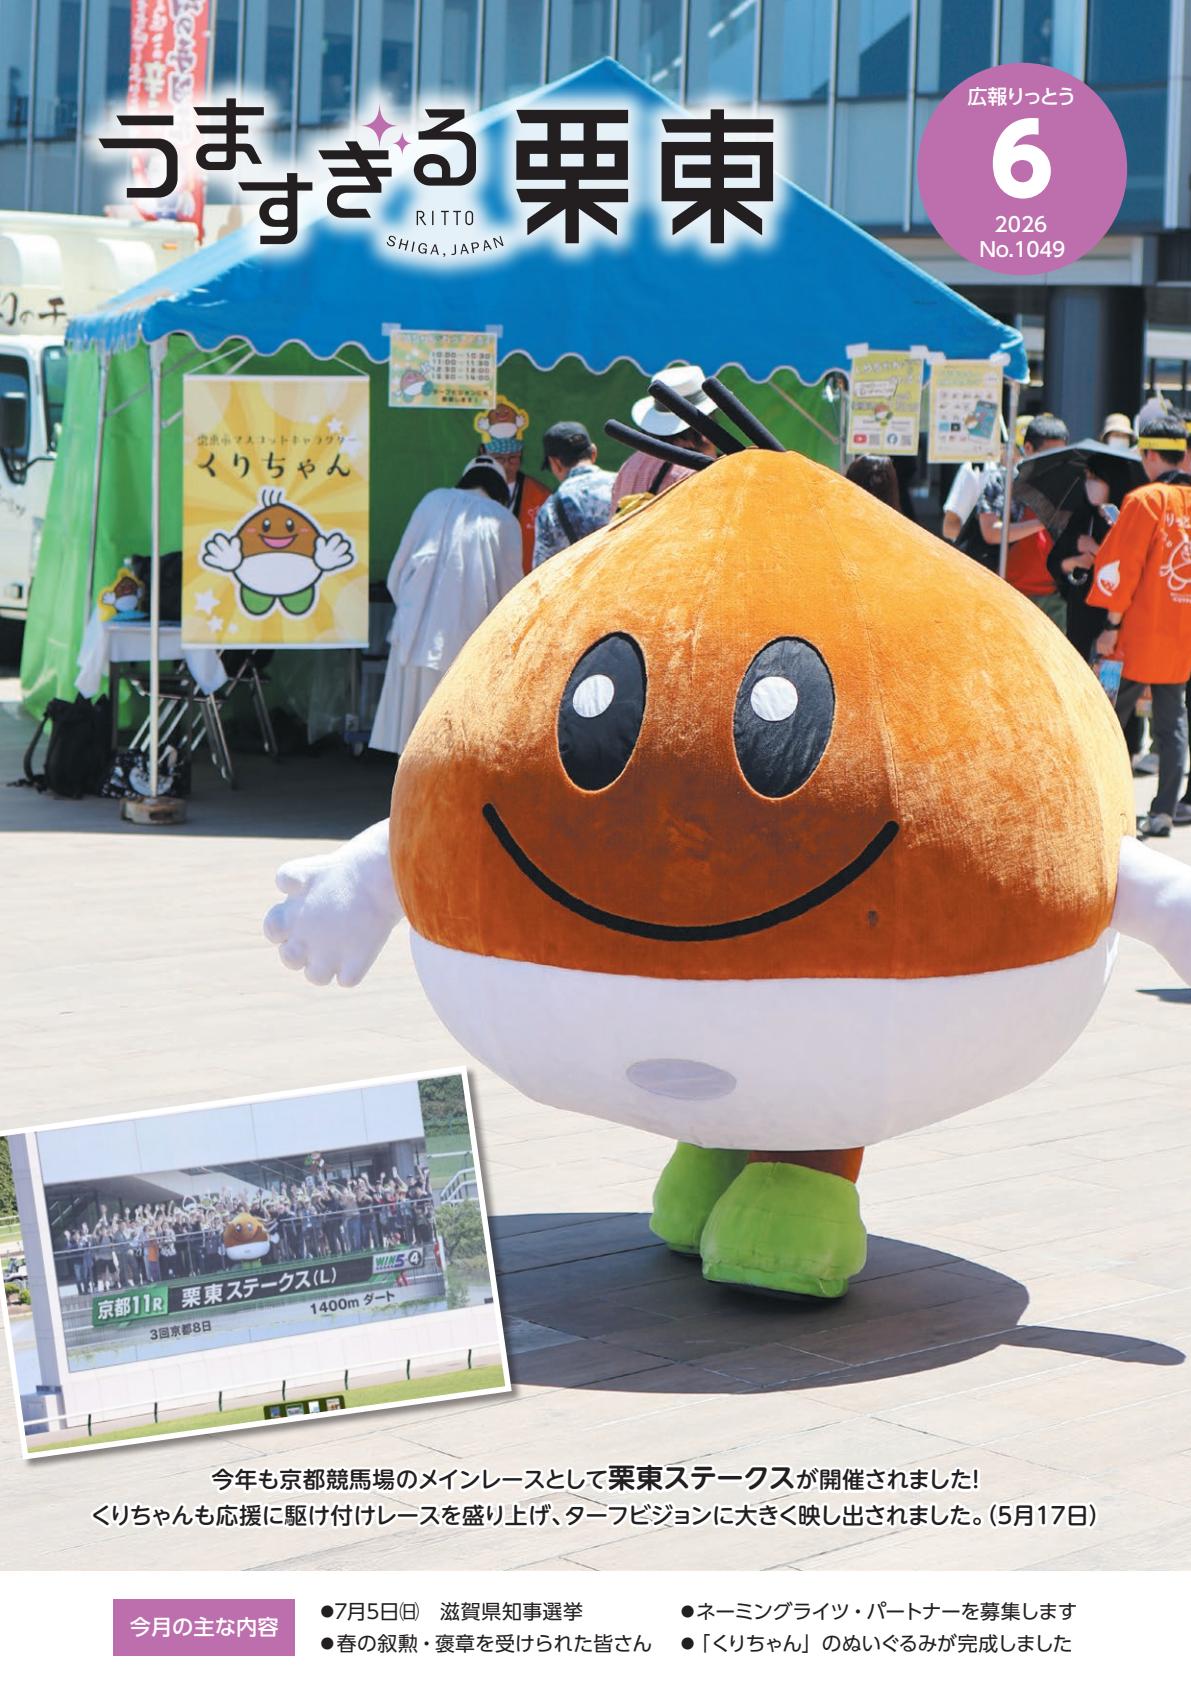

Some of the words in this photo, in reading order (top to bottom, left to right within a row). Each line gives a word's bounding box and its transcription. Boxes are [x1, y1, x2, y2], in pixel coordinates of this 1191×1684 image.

[198, 451, 351, 480] くりちゃん
[375, 1253, 406, 1269] WIN5
[310, 1298, 360, 1315] 1400m
[363, 1291, 396, 1306] ダート
[150, 1320, 212, 1340] 3回京都8日
